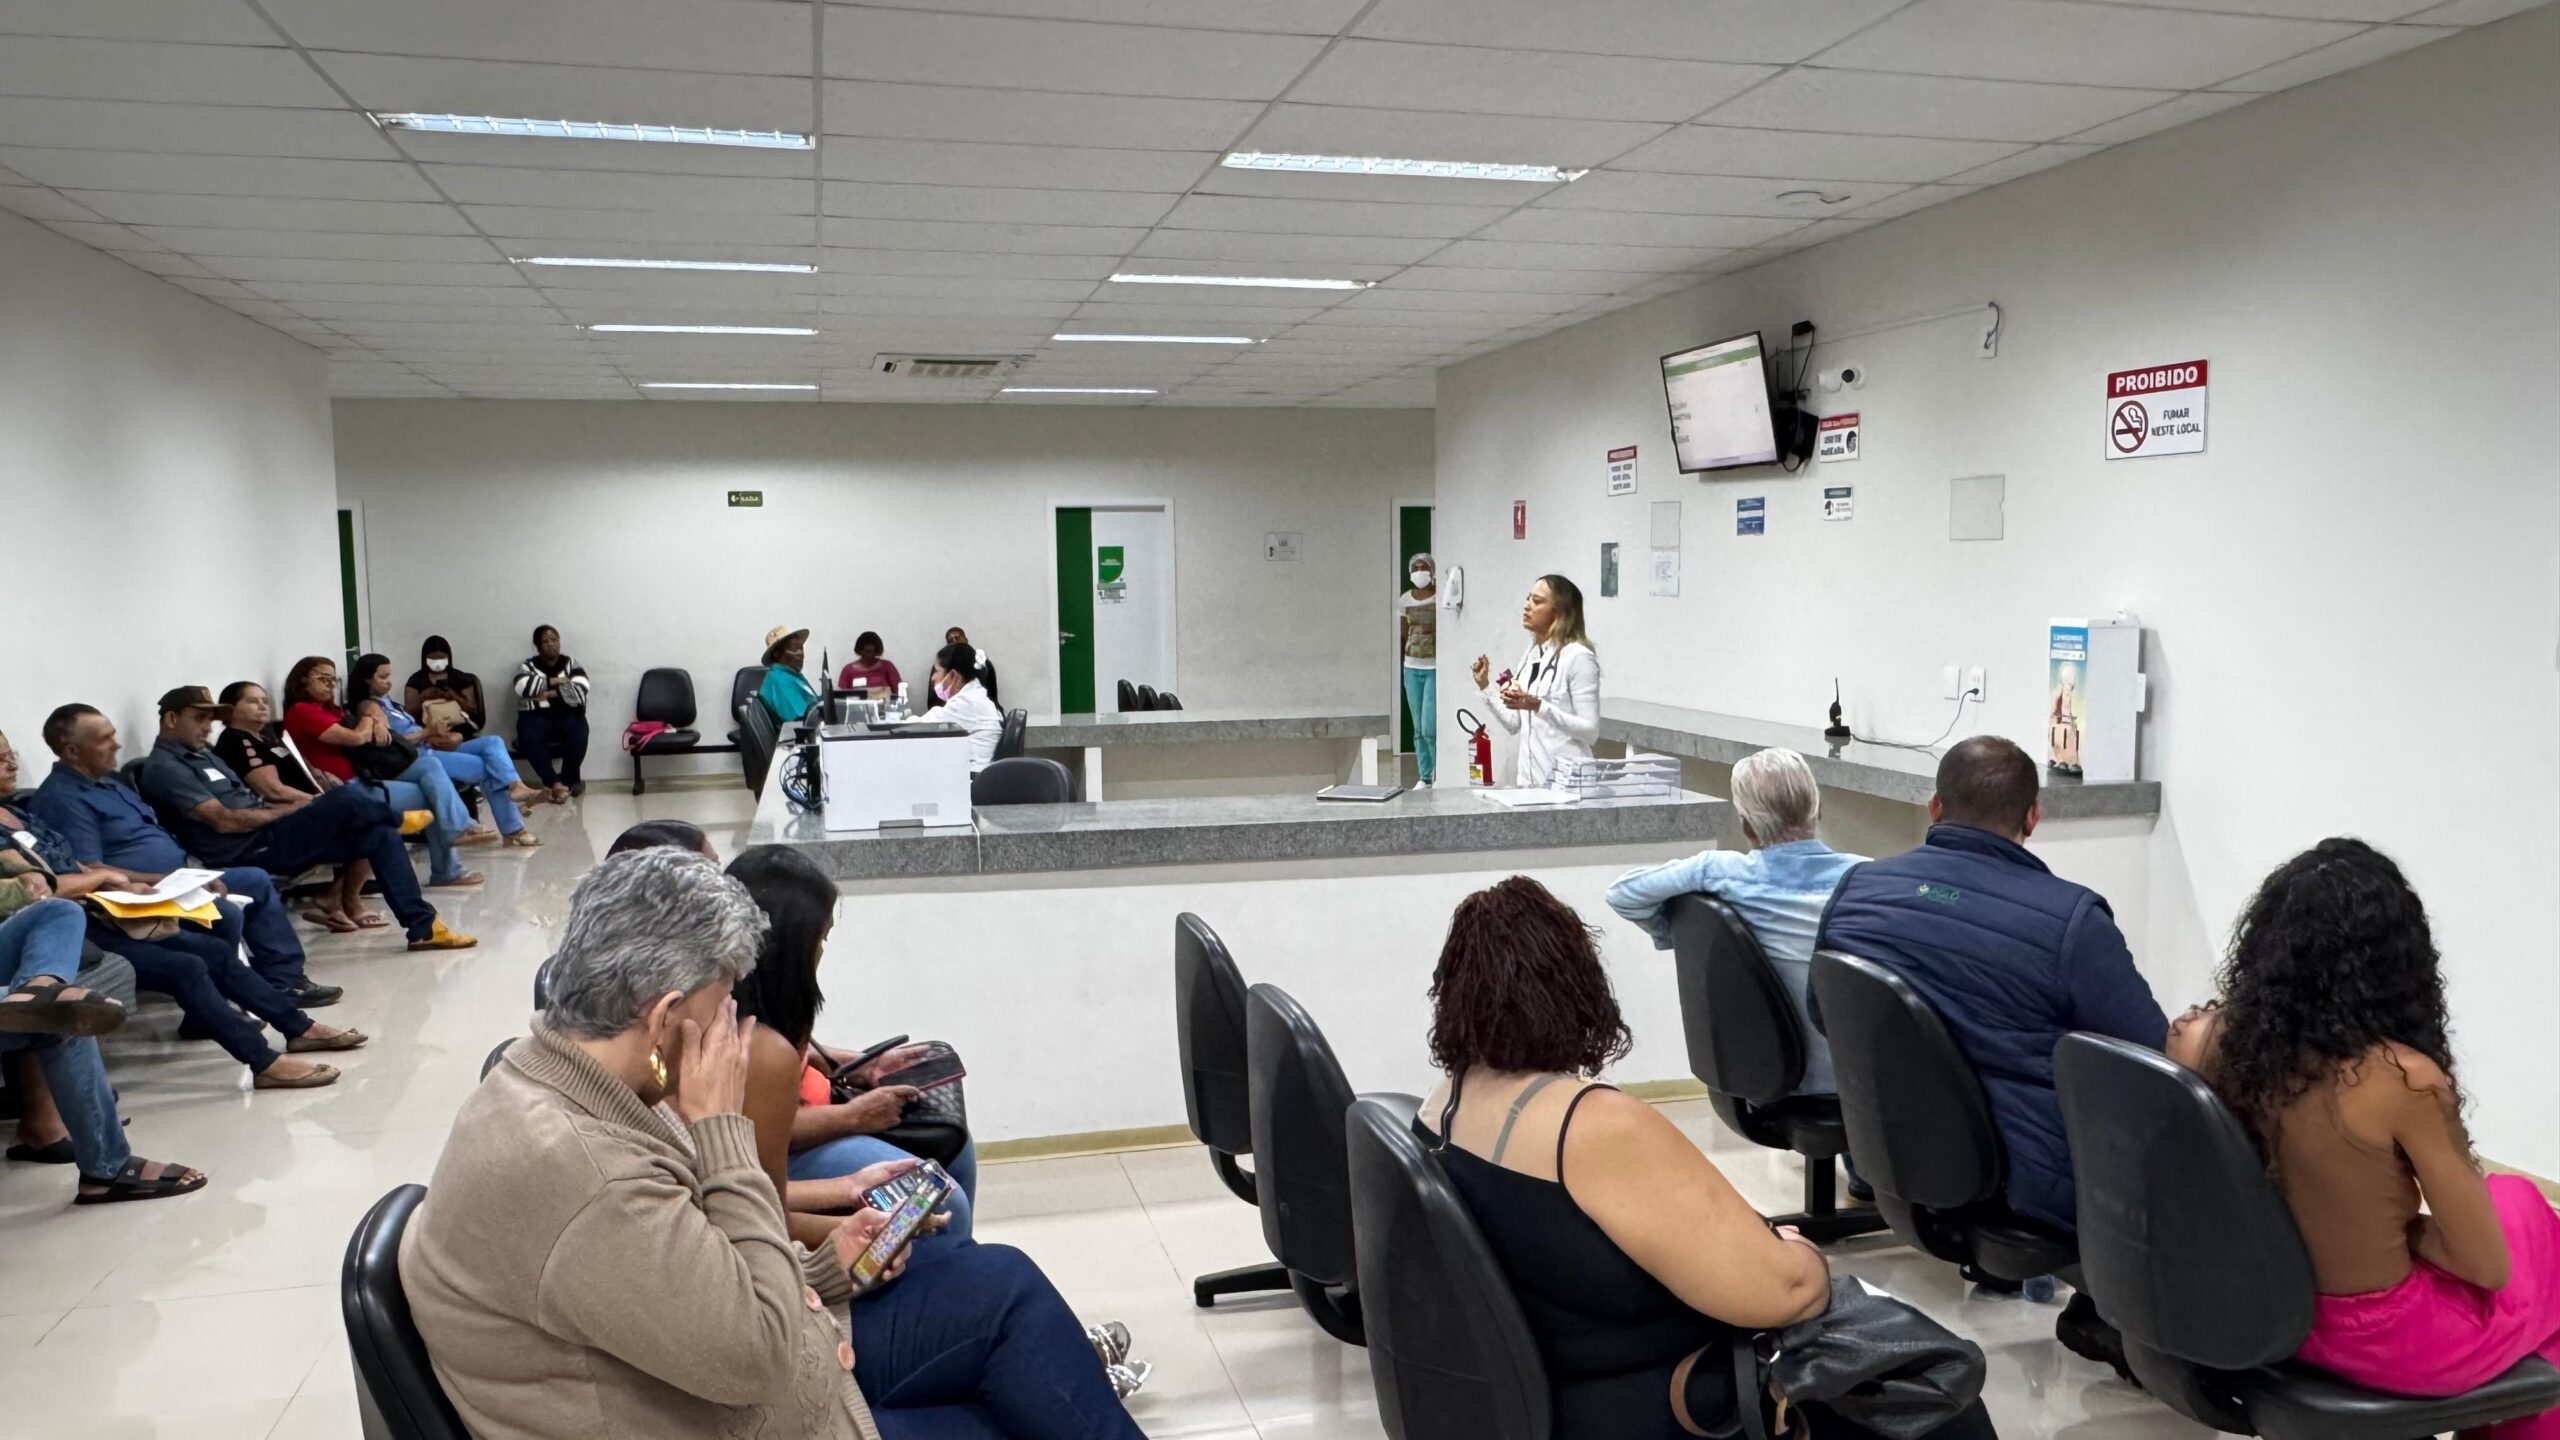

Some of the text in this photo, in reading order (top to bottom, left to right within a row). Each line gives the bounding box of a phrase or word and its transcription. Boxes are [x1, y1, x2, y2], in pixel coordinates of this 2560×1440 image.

[2115, 366, 2198, 393] PROIBIDO
[2163, 407, 2189, 420] FUMAR
[2151, 423, 2201, 436] NESTE LOCAL
